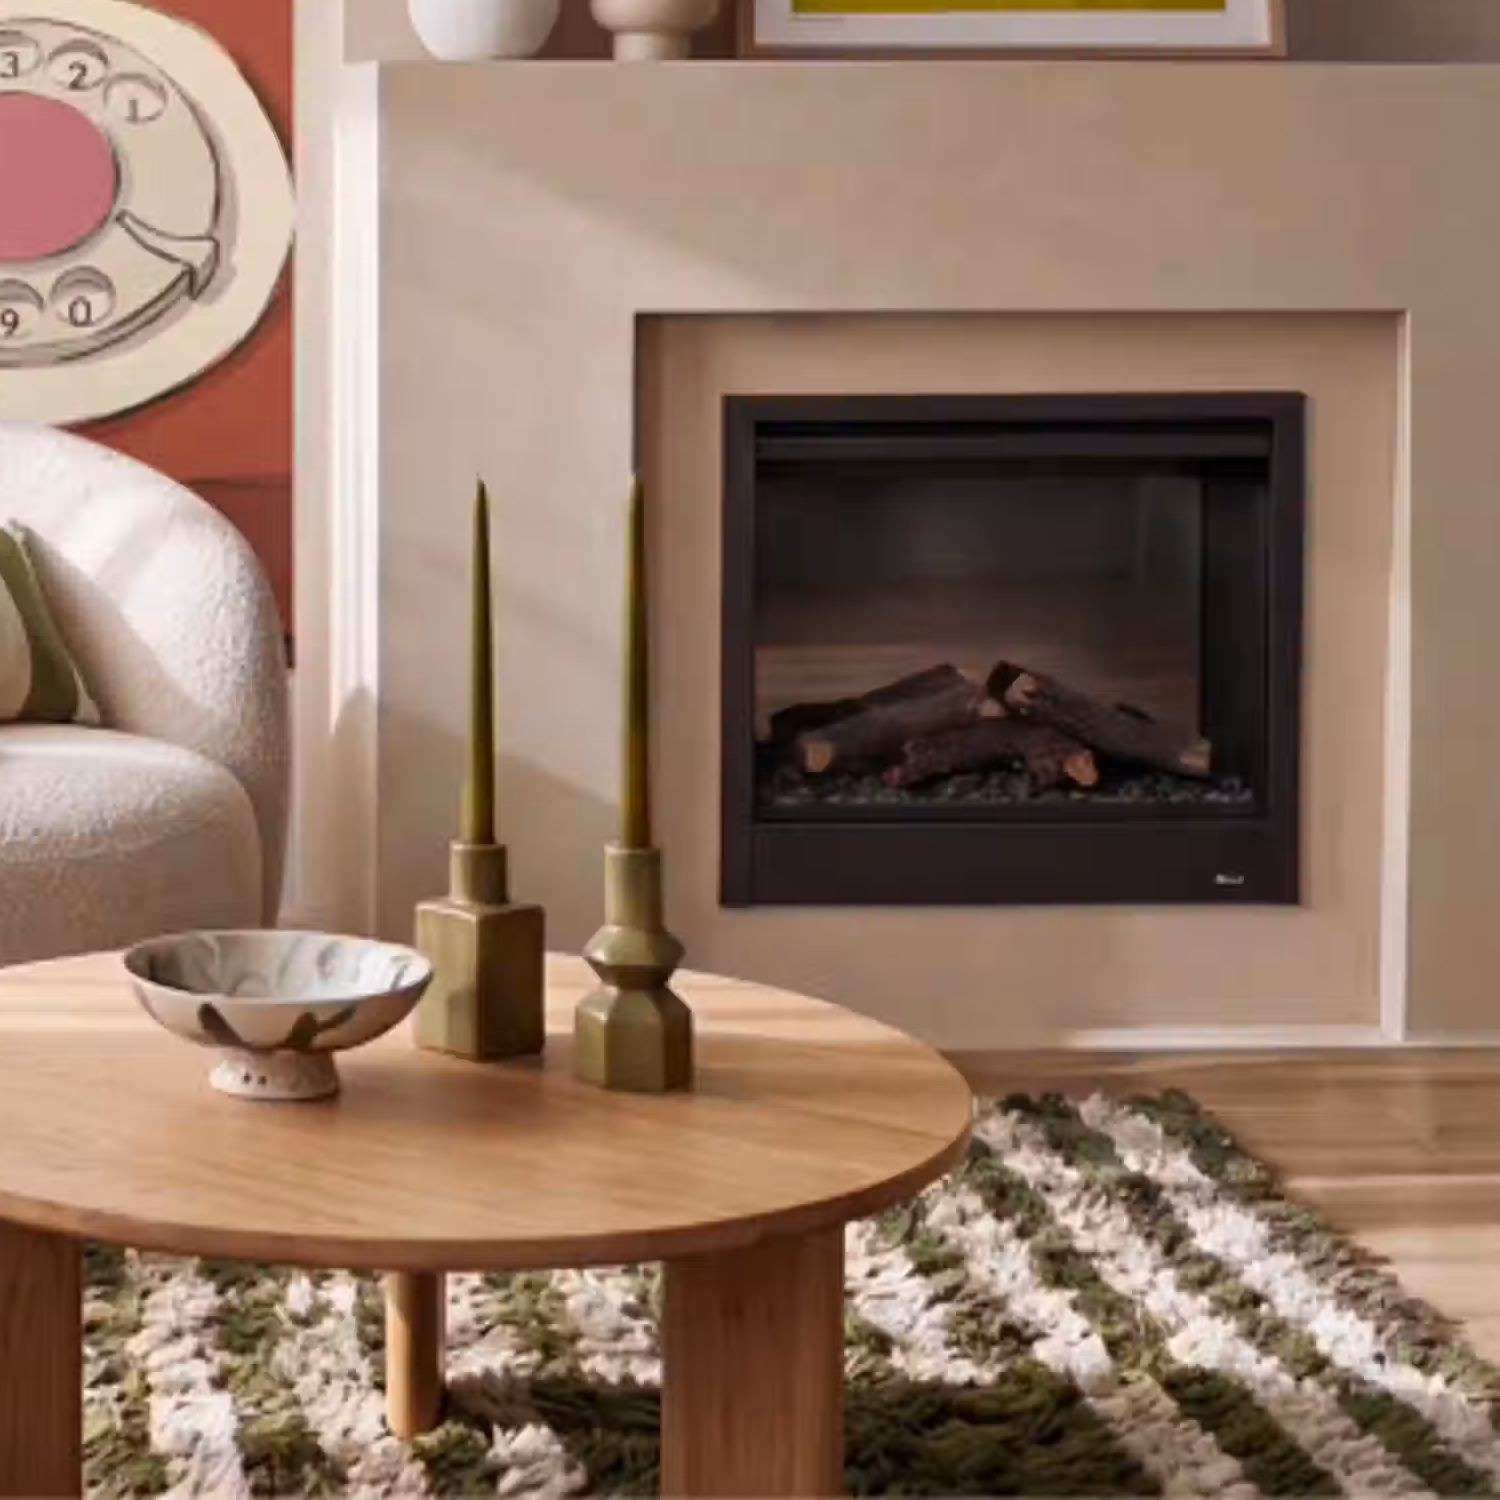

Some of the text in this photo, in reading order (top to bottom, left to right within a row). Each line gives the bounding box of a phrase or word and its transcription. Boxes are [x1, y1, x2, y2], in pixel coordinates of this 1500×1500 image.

[0, 50, 19, 79] 3
[67, 59, 89, 91] 2
[124, 97, 140, 124] 1
[0, 307, 20, 338] 9
